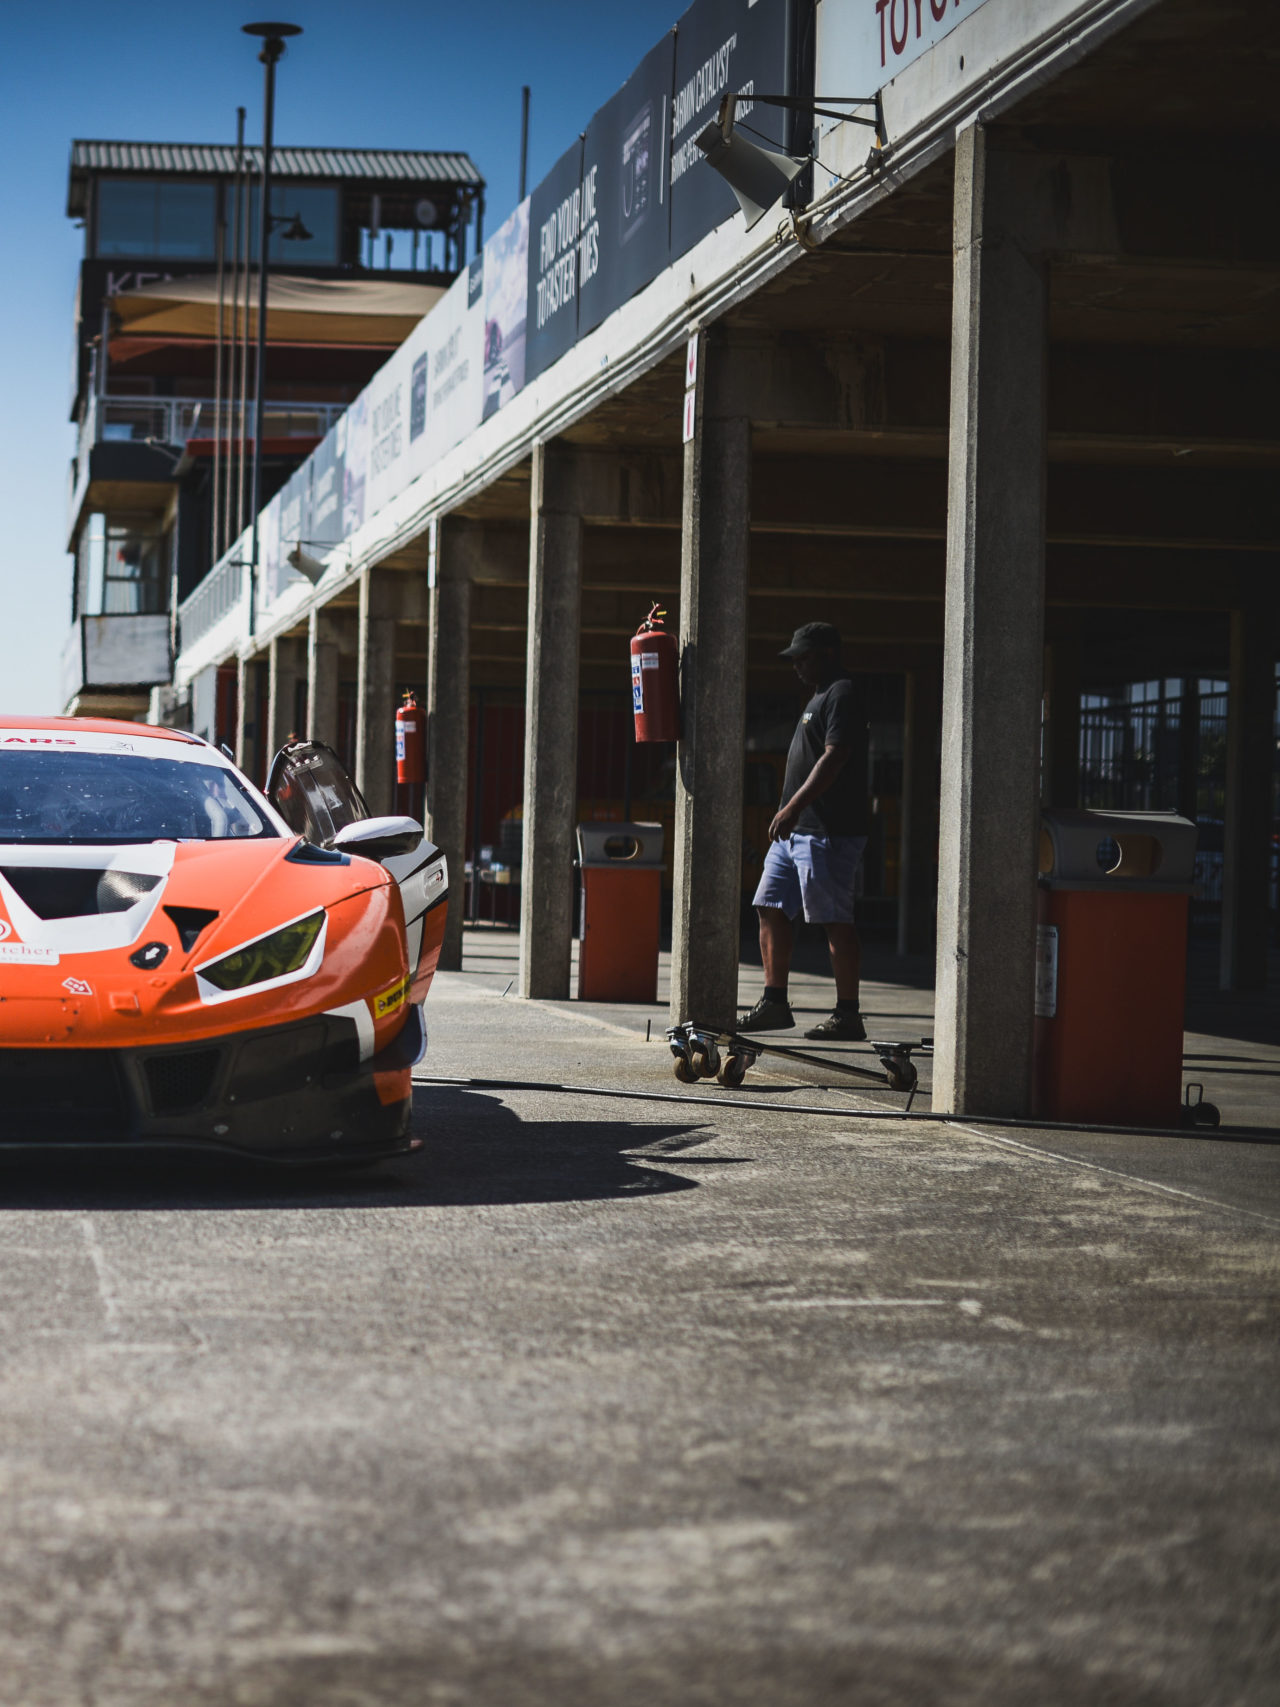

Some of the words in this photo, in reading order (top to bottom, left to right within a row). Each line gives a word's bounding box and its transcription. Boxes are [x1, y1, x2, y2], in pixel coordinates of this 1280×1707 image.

[876, 0, 960, 67] TOY
[672, 76, 695, 139] GARMIN
[540, 213, 557, 274] FIND
[557, 188, 580, 253] YOUR
[580, 164, 598, 230] LINE
[536, 277, 547, 330] TO
[547, 249, 576, 320] FASTER
[576, 221, 600, 288] TIMES
